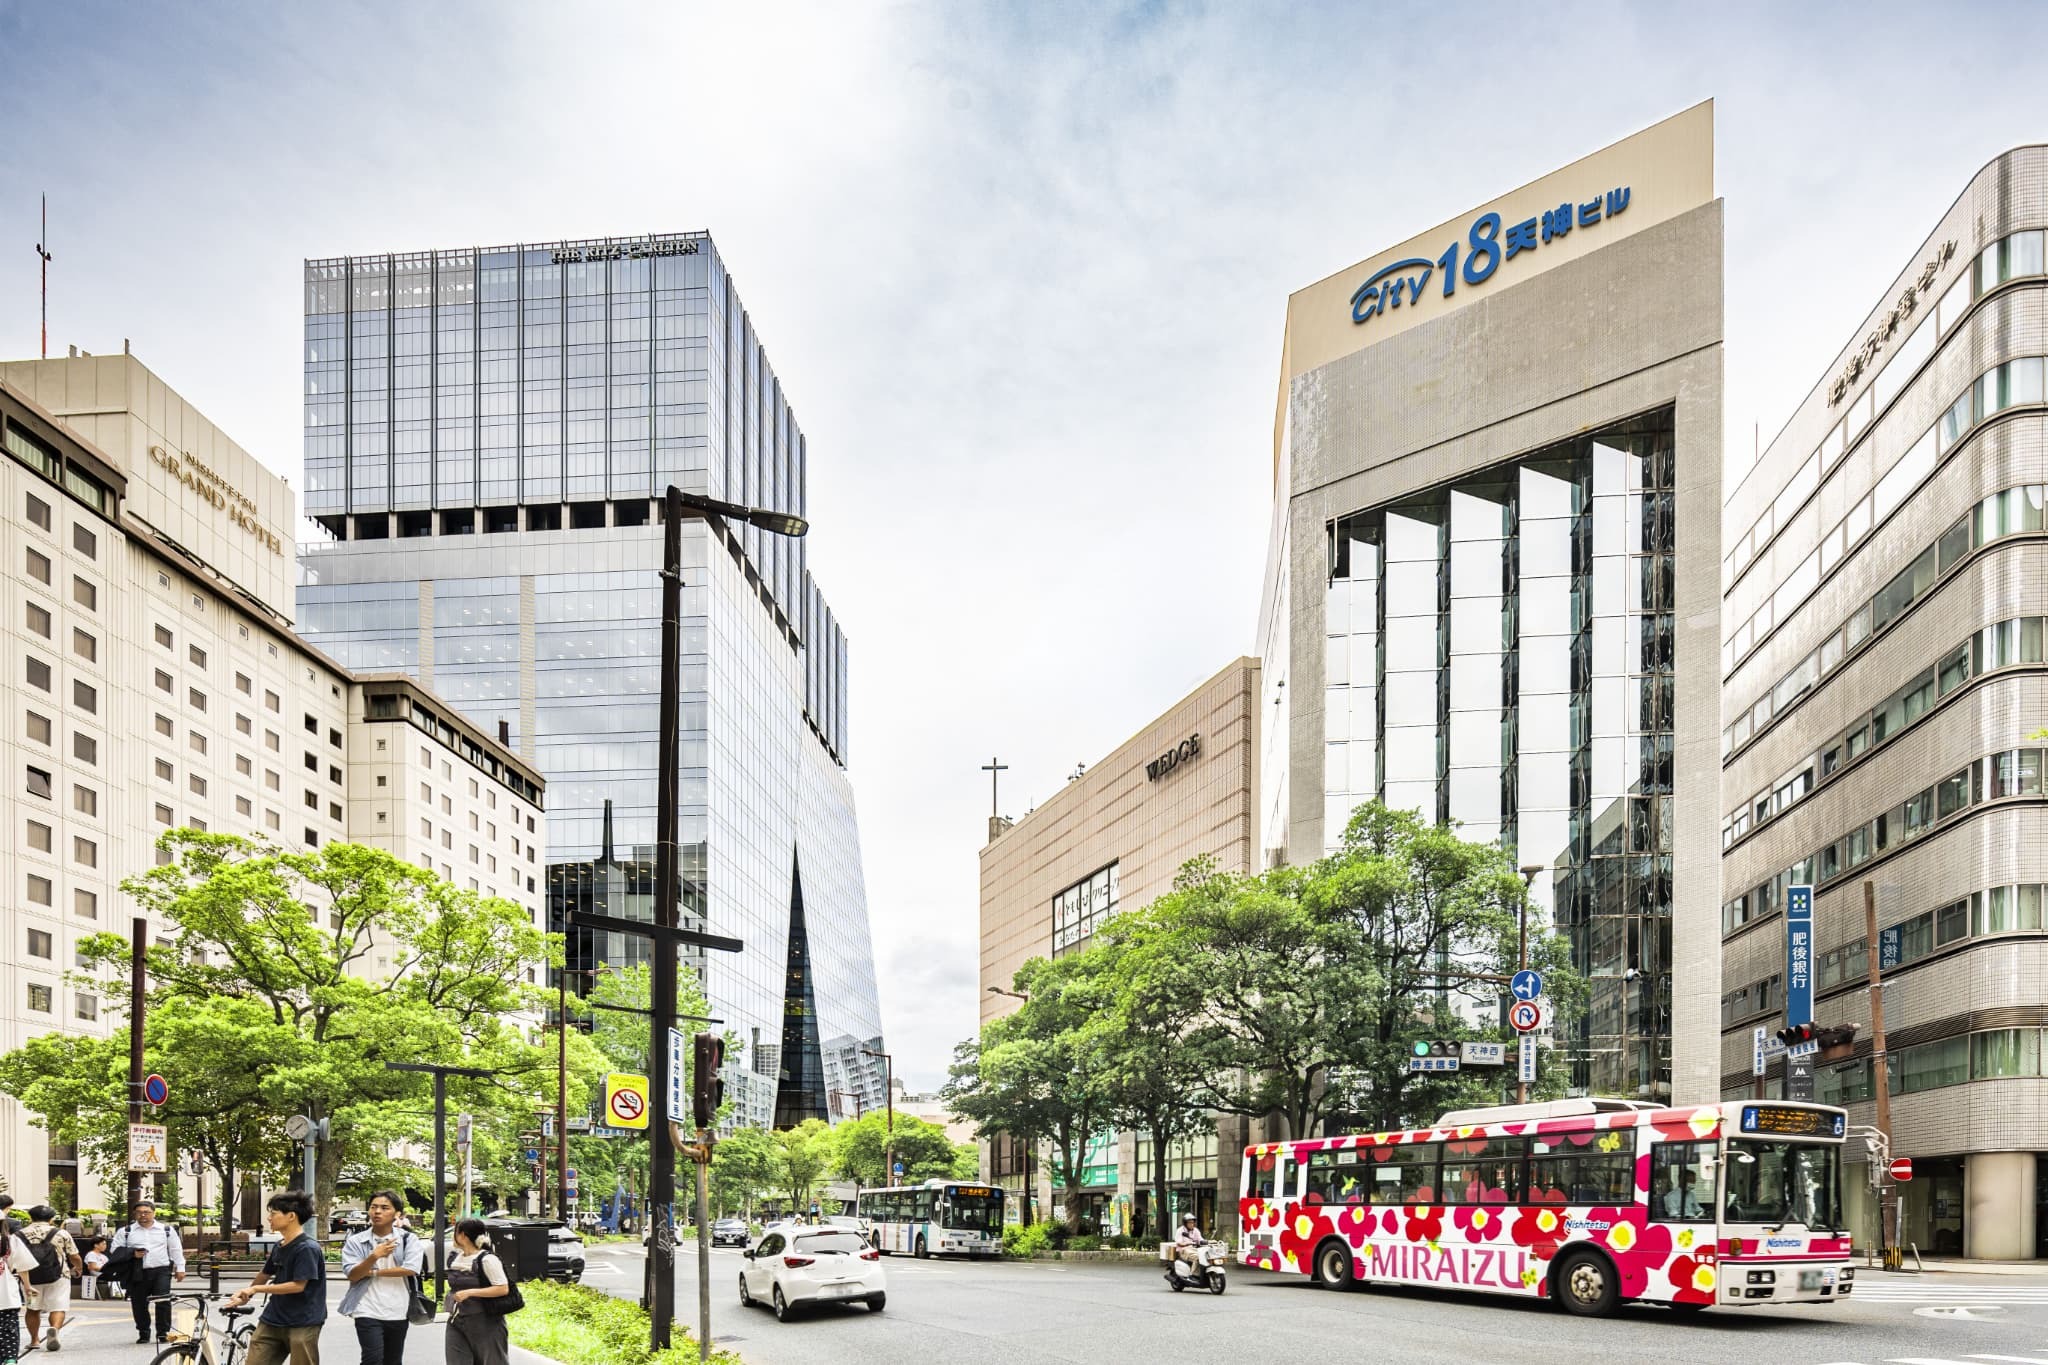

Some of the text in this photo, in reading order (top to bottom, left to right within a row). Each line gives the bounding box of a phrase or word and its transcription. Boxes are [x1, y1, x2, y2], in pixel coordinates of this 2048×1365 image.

[551, 247, 582, 264] THE
[1352, 187, 1631, 323] City 18 天神ビル
[151, 445, 285, 557] GRAND HOTEL
[186, 451, 257, 515] NISHITETSU
[1145, 733, 1200, 782] WEDGE
[1792, 932, 1808, 989] 肥後銀行
[1411, 1060, 1457, 1070] 時差信号
[1468, 1046, 1499, 1056] 天神西
[1565, 1220, 1609, 1230] Nishitetsu
[1371, 1244, 1526, 1289] MIRAIZU
